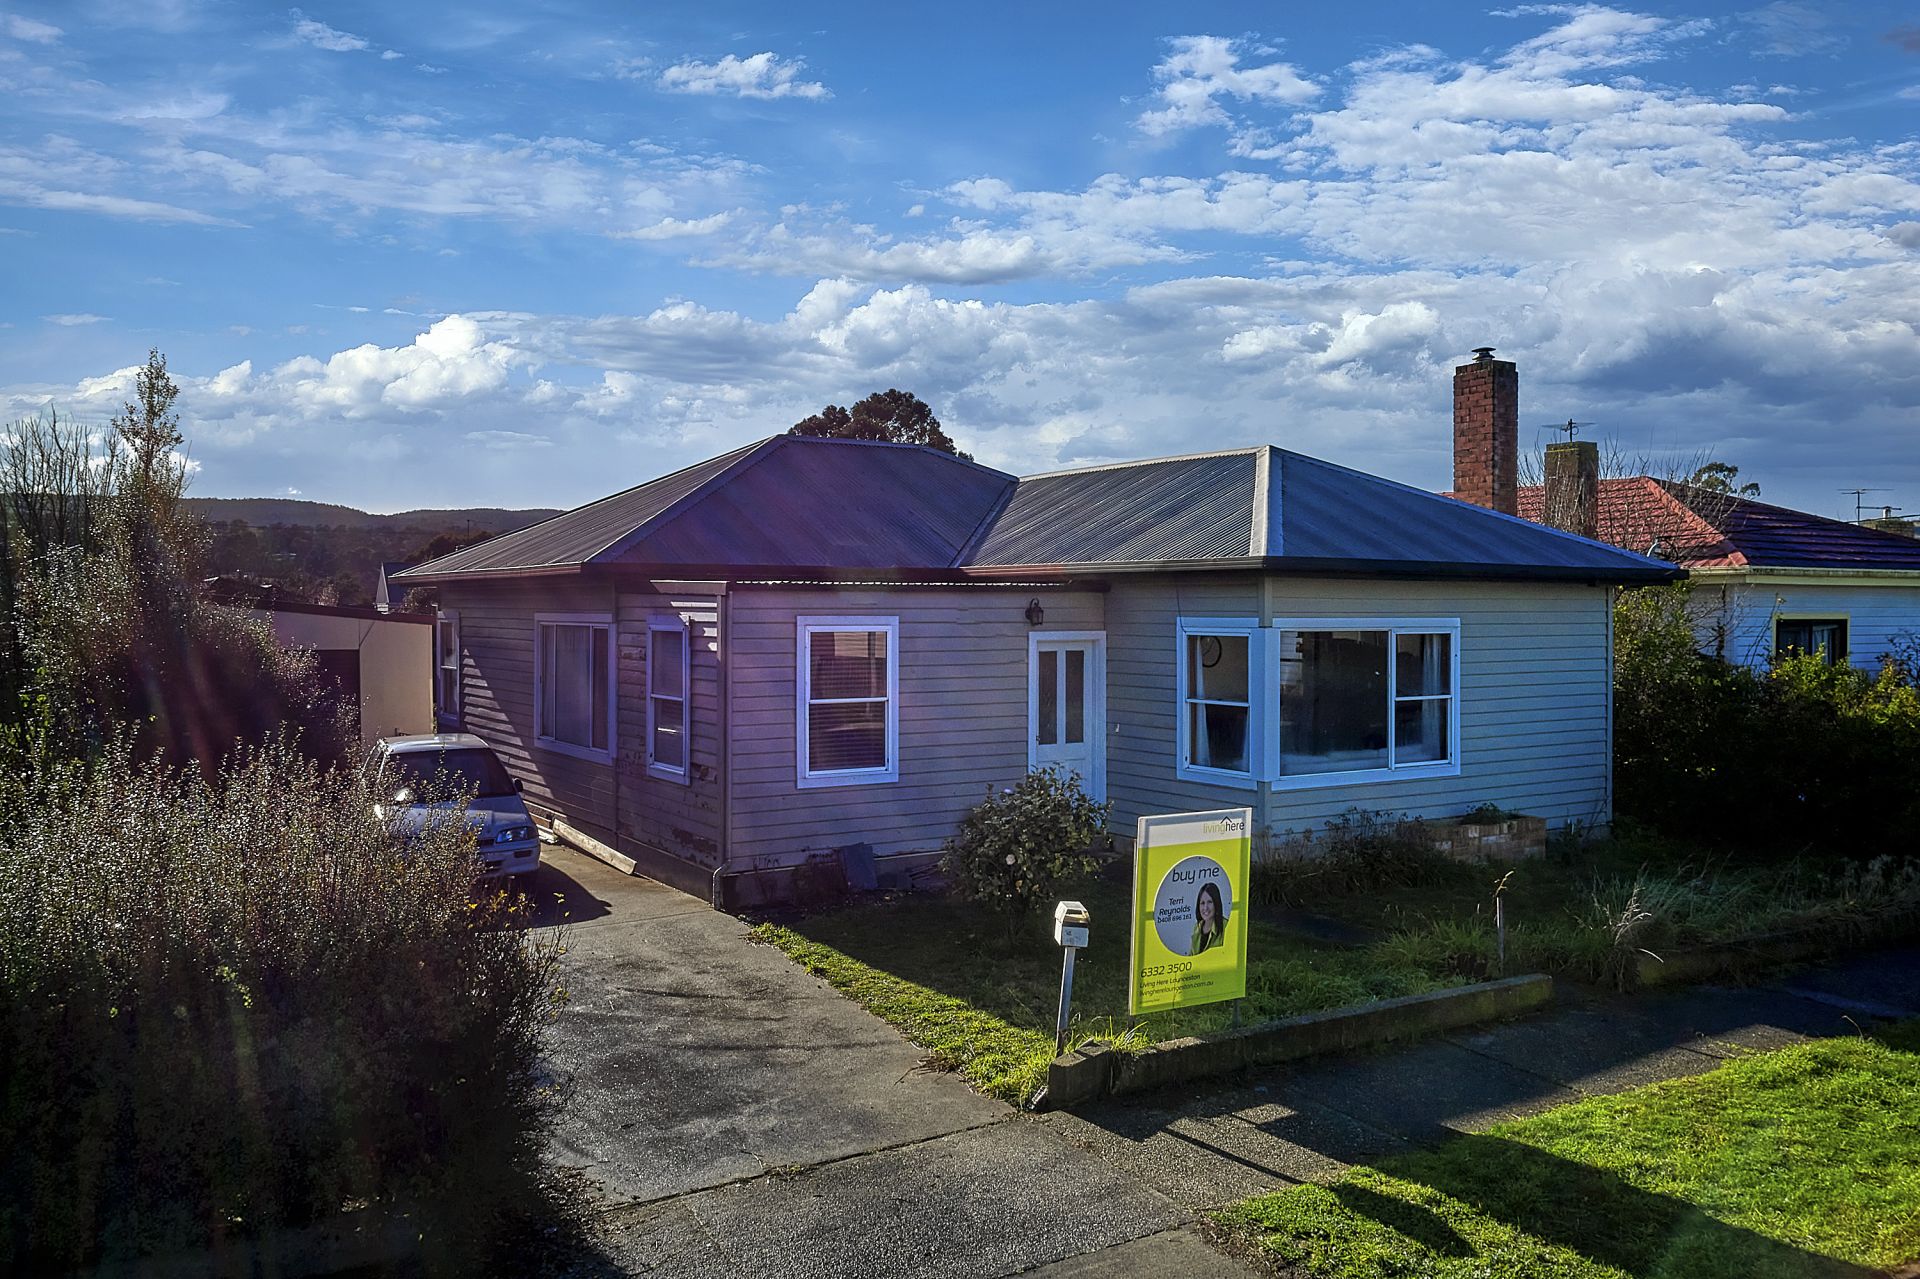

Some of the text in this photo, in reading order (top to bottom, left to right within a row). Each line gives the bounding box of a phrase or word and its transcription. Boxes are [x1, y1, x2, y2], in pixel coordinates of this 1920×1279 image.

[1203, 821, 1245, 834] livinghere
[1172, 867, 1220, 885] buy me
[1169, 896, 1184, 906] Terri
[1159, 905, 1191, 917] Reynolds
[1140, 962, 1192, 978] 6332 3500
